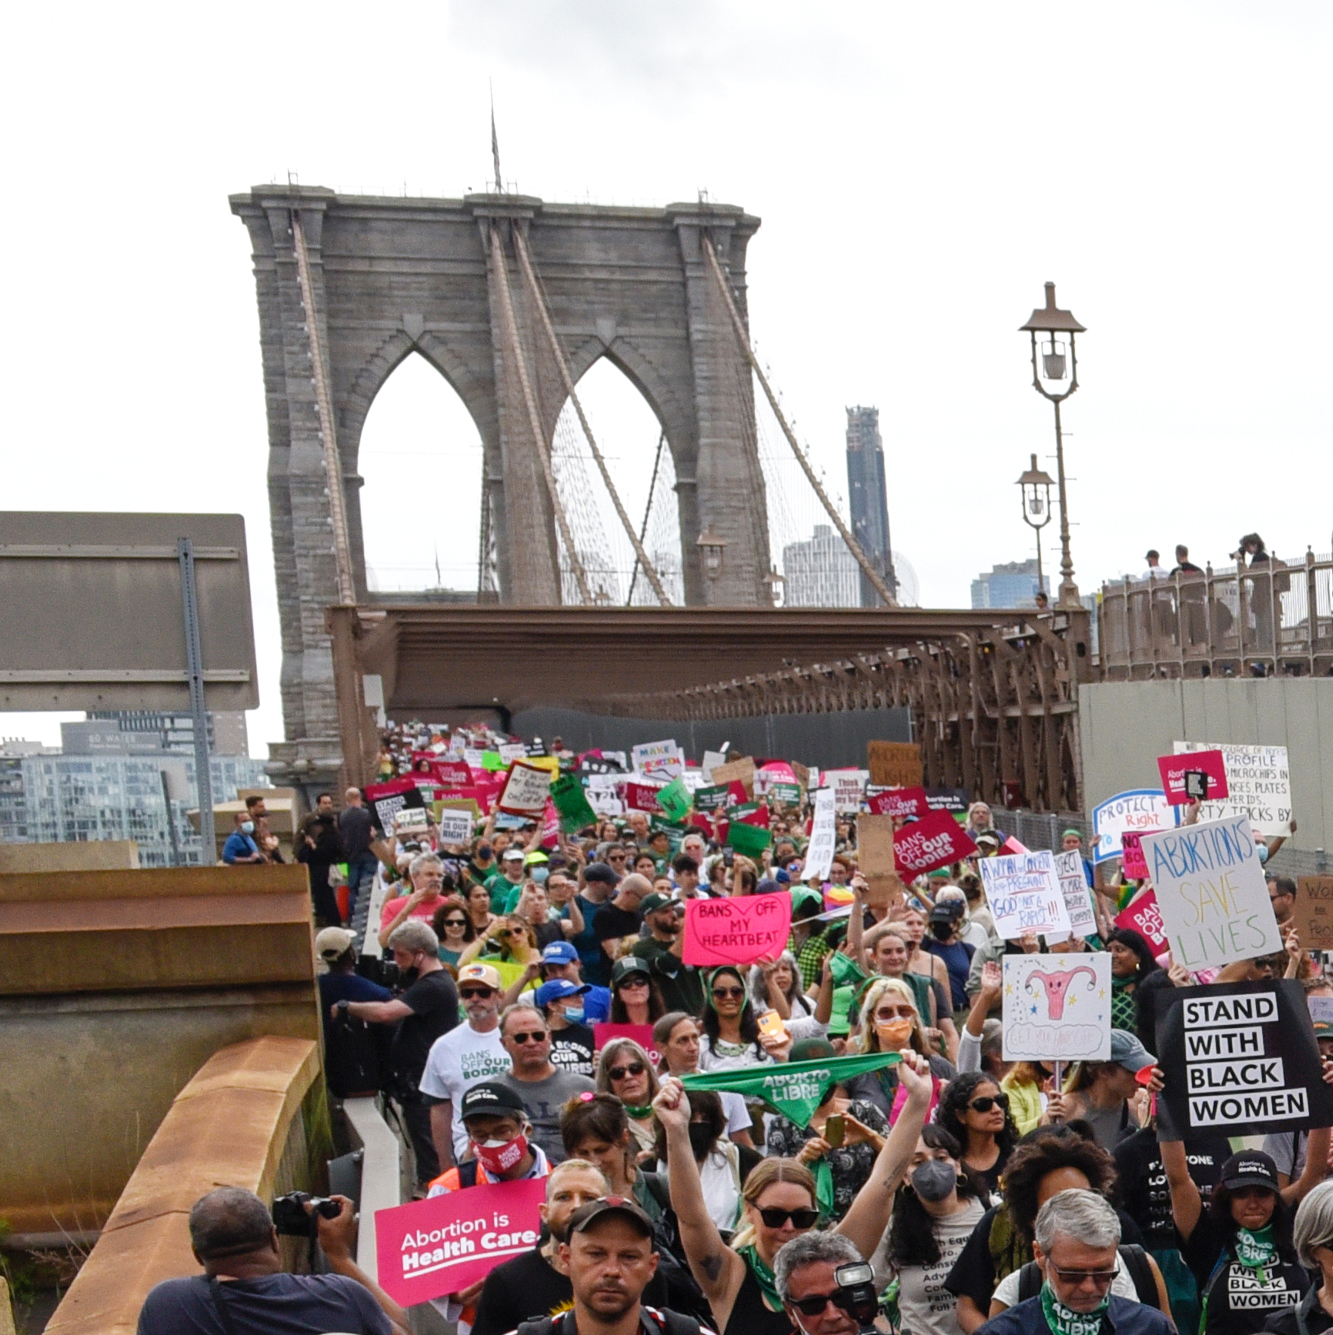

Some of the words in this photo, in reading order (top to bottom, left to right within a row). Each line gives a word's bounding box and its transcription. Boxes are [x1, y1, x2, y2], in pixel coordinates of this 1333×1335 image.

[640, 746, 670, 756] MAKE
[1226, 754, 1277, 766] PROFILE
[1230, 767, 1277, 780] MICROCHIPS
[1280, 769, 1289, 780] IN
[1255, 783, 1287, 795] PLATES
[1100, 796, 1156, 823] PROTECT
[1278, 808, 1292, 822] BY
[1126, 813, 1161, 829] Right
[442, 831, 469, 839] RIGHT
[893, 832, 925, 854] BANS
[899, 849, 922, 865] OFF
[922, 832, 953, 851] OUR
[906, 844, 955, 870] BODIES
[1153, 819, 1254, 885] ABORTIONS
[1179, 870, 1249, 928] SAVE
[699, 904, 733, 918] BANS
[756, 901, 778, 916] OFF
[1134, 902, 1161, 927] BAN
[730, 918, 751, 933] MY
[702, 930, 779, 947] HEARTBEAT
[1177, 914, 1267, 966] LIVES
[1187, 998, 1274, 1023] STAND
[1188, 1031, 1259, 1056] WITH
[461, 1050, 491, 1061] BANS
[461, 1060, 484, 1071] OFF
[484, 1058, 511, 1069] OUR
[551, 1052, 577, 1063] OUR
[463, 1066, 506, 1079] BODIES
[1190, 1062, 1280, 1089] BLACK
[772, 1083, 821, 1102] LIBRE
[1193, 1092, 1305, 1121] WOMEN
[401, 1217, 487, 1251] Abortion
[493, 1212, 510, 1228] is
[402, 1240, 476, 1271] Health
[480, 1229, 541, 1250] Care.
[1231, 1293, 1298, 1307] WOMEN
